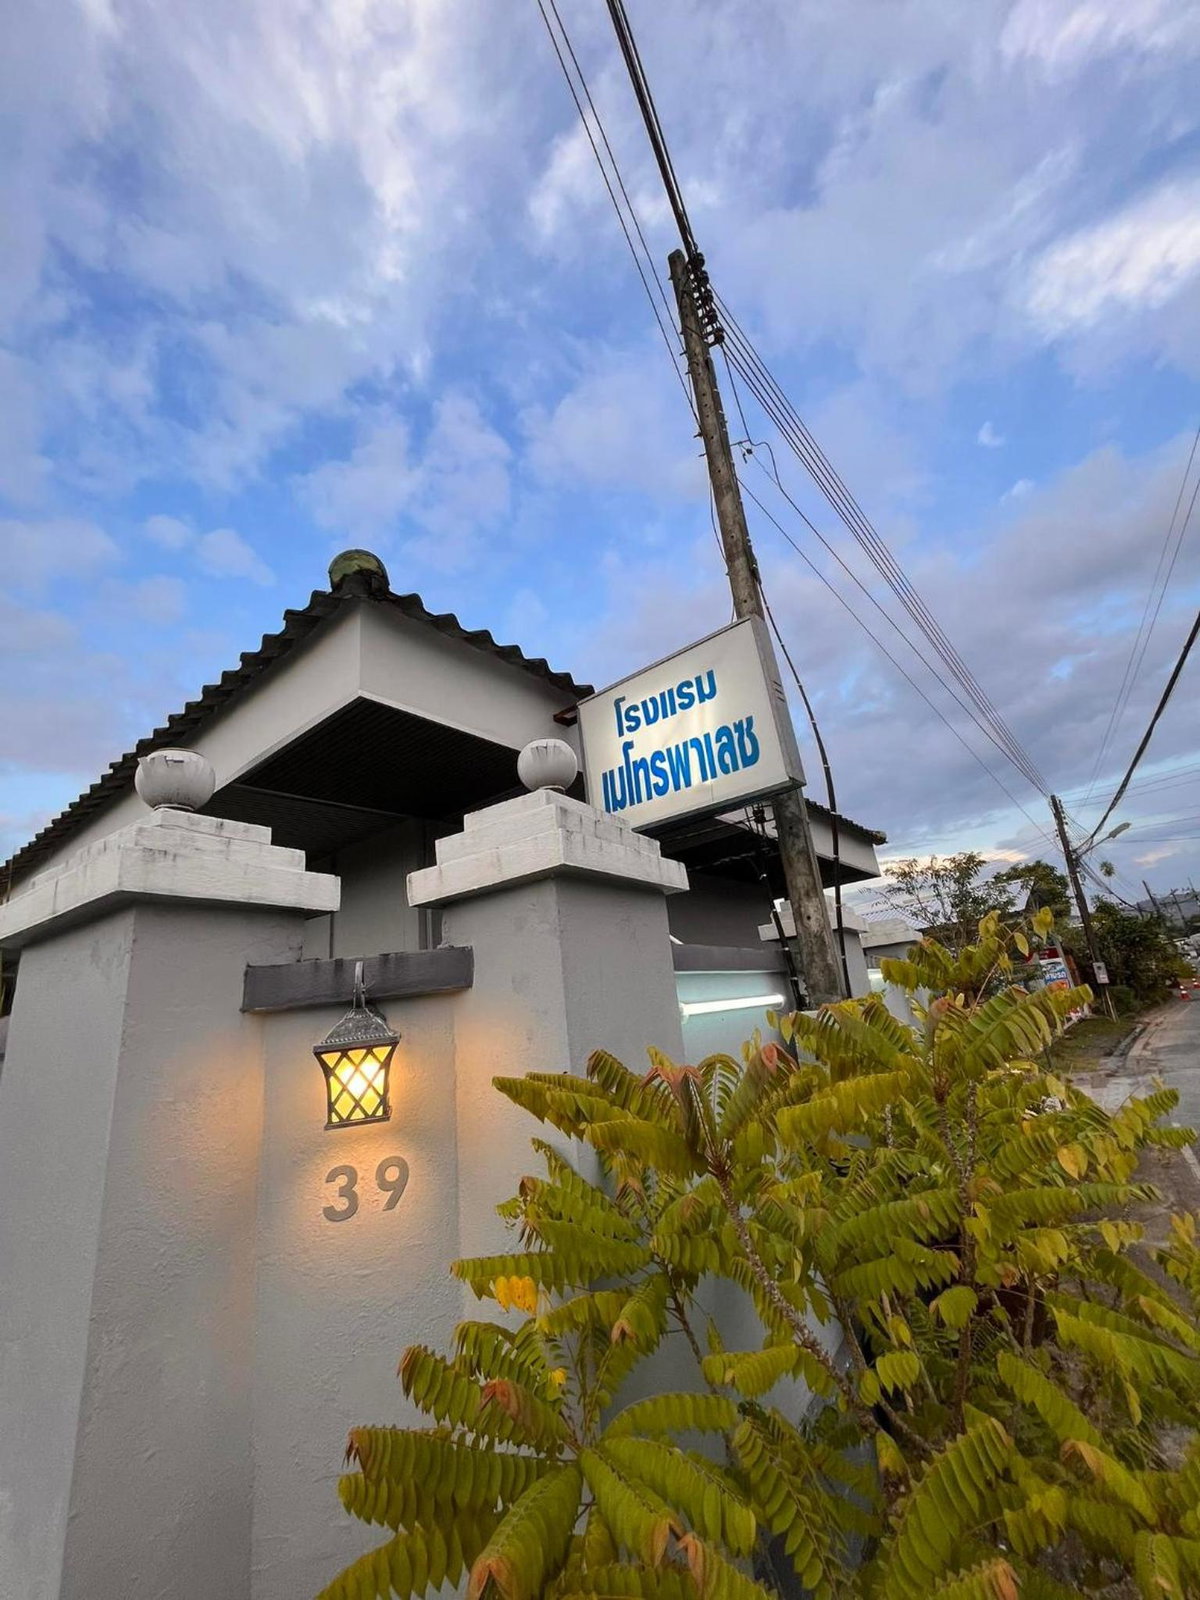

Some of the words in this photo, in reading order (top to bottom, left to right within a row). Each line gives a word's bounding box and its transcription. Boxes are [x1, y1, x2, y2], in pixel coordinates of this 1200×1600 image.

[613, 669, 718, 738] โรงแรม
[602, 715, 760, 814] เมโทรพาเลซ
[322, 1155, 410, 1222] 39
